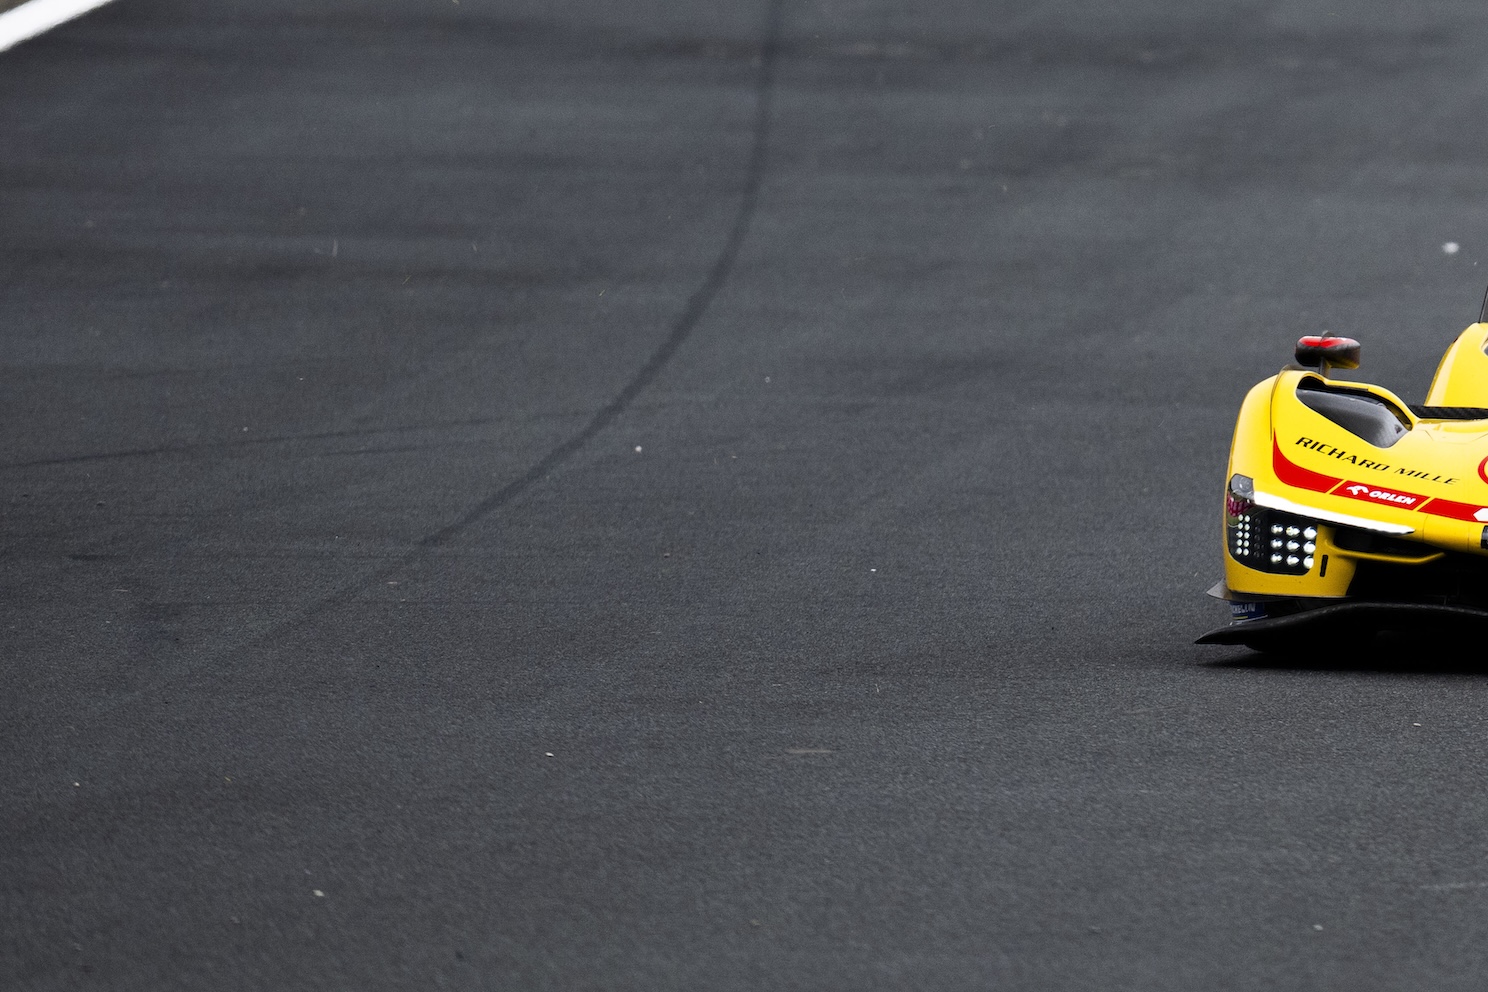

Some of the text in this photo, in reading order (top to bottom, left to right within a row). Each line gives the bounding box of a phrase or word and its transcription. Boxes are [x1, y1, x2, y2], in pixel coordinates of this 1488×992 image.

[1295, 436, 1461, 485] RICHARD MILLE
[1368, 490, 1417, 505] ORLEN
